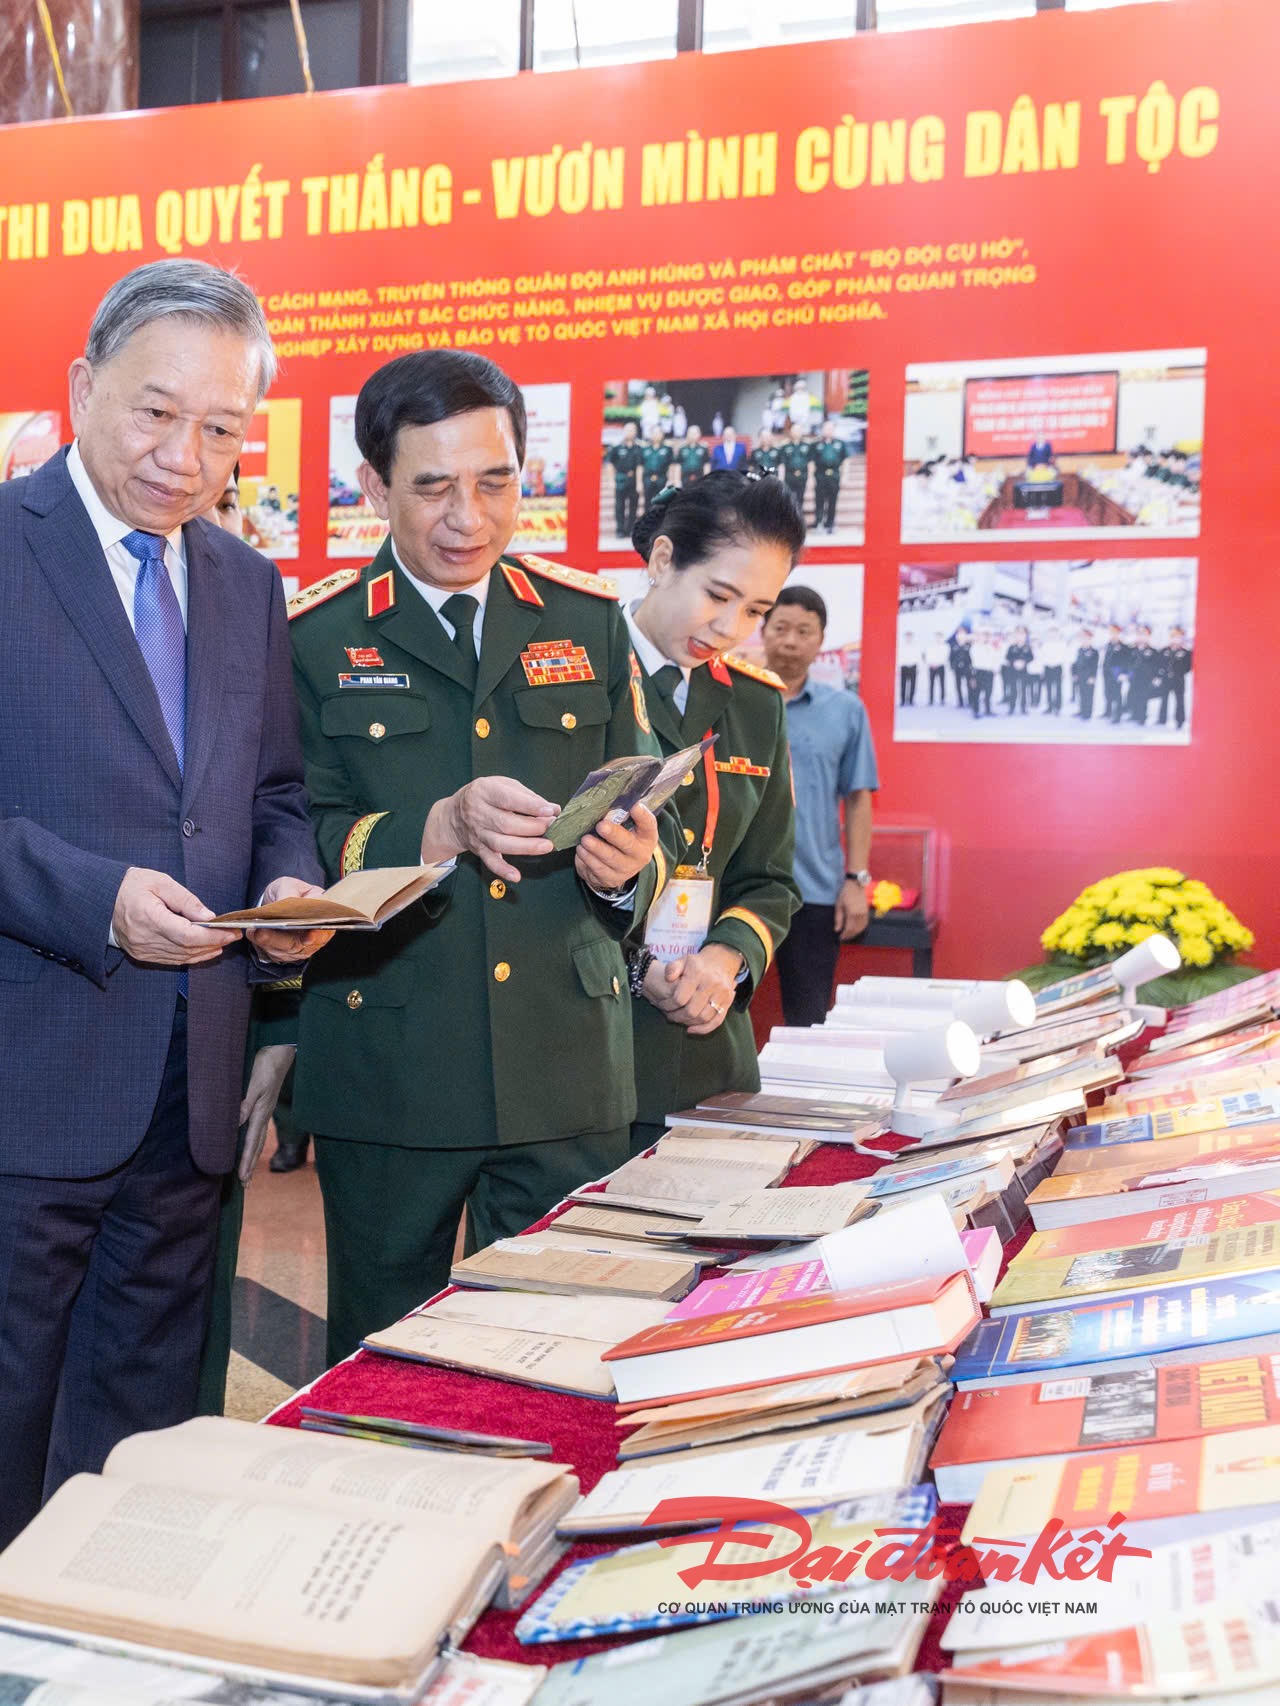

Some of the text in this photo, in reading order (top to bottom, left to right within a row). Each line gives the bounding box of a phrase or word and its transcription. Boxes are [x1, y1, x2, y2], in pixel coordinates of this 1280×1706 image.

[61, 194, 143, 257] ĐUA
[155, 163, 290, 254] QUYẾT
[302, 154, 453, 237] THẮNG
[492, 141, 625, 219] VƯƠN
[641, 131, 778, 207] MÌNH
[794, 114, 946, 193] CÙNG
[964, 93, 1081, 179] DÂN
[1100, 79, 1221, 175] TỘC
[266, 317, 306, 336] OÀN
[309, 307, 367, 334] THÀNH
[457, 300, 510, 323] CHỨC
[573, 292, 633, 315] NHIỆM
[636, 291, 663, 313] VỤ
[665, 286, 725, 309] ĐƯỢC
[787, 277, 833, 301] GÓP
[835, 273, 893, 297] PHẦN
[895, 270, 957, 294] QUAN
[960, 264, 1038, 290] TRỌNG
[267, 291, 315, 313] CÁCH
[377, 280, 446, 304] TRUYỀN
[450, 276, 511, 298] THỐNG
[514, 271, 568, 295] QUÂN
[570, 269, 604, 292] ĐỘI
[606, 268, 647, 287] ANH
[649, 262, 705, 284] HÙNG
[708, 257, 737, 279] VÀ
[800, 248, 858, 273] CHẤT
[903, 244, 943, 267] ĐỘI
[945, 242, 977, 265] CỤ
[334, 333, 370, 355] XÂY
[372, 331, 424, 355] DỰNG
[426, 328, 453, 350] VÀ
[454, 324, 495, 348] BẢO
[496, 324, 522, 347] VỆ
[553, 318, 608, 343] QUỐC
[610, 315, 654, 340] VIỆT
[655, 313, 701, 335] NAM
[733, 309, 769, 332] HỘI
